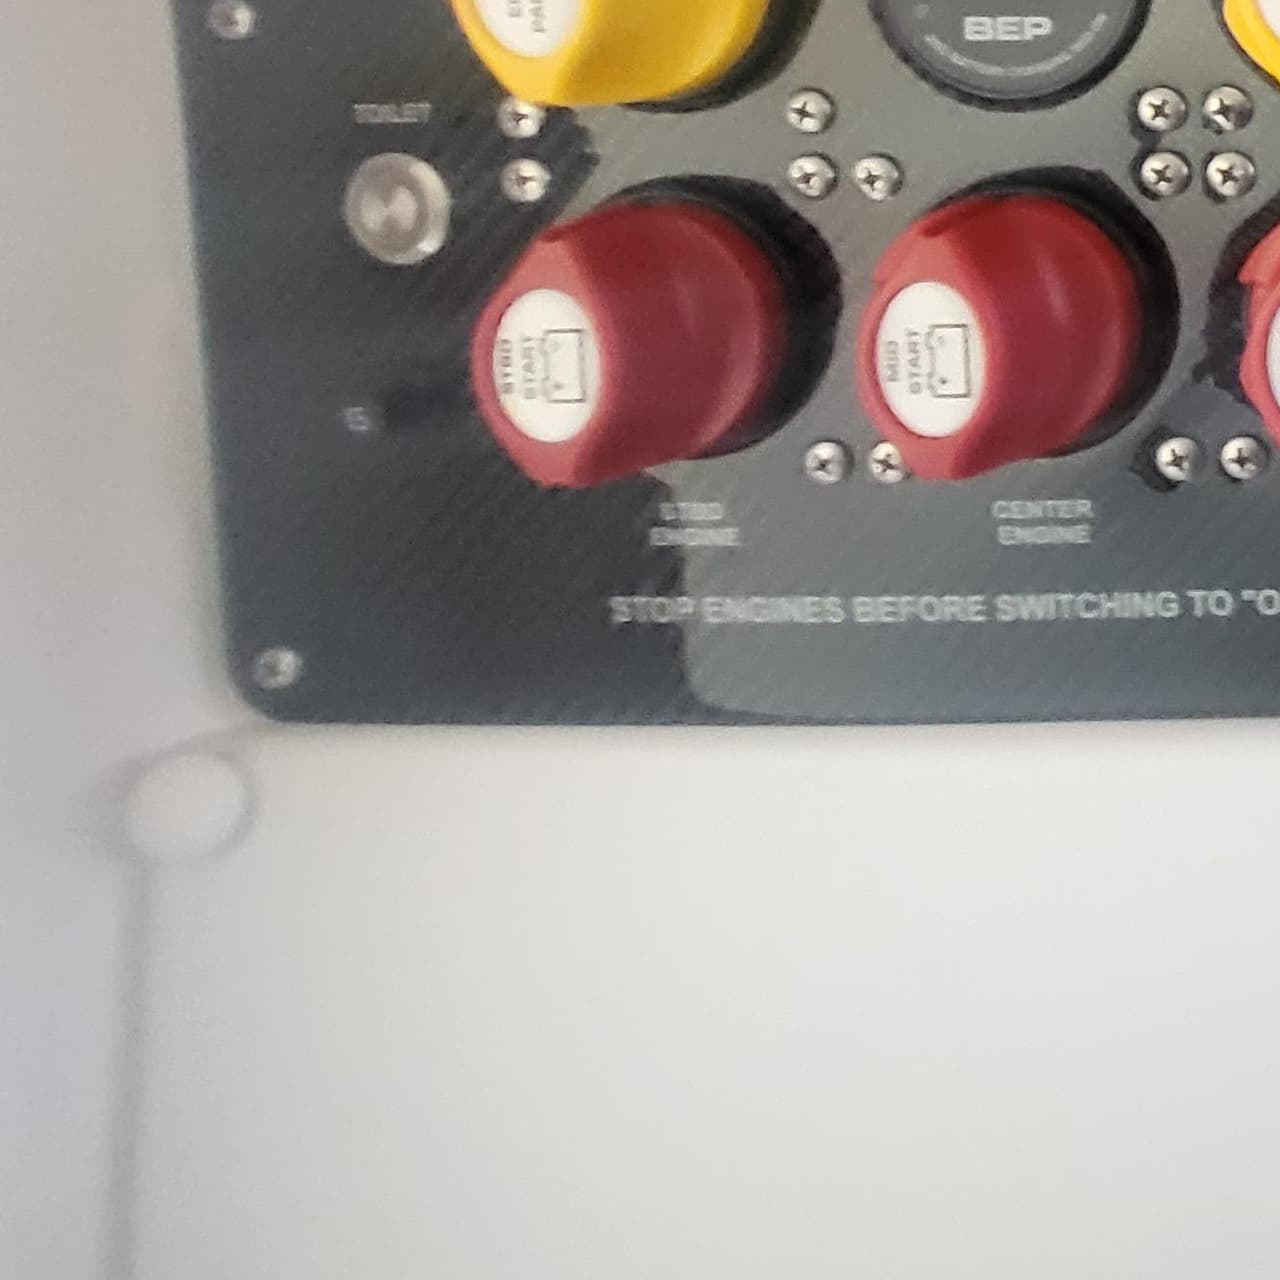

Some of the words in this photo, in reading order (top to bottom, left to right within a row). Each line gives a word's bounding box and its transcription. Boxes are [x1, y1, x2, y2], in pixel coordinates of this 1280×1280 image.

[964, 16, 1051, 41] BEP
[608, 596, 696, 623] STOP
[702, 596, 846, 623] ENGINES
[853, 594, 988, 622] BEFORE
[996, 591, 1179, 619] SWITCHING
[1186, 589, 1234, 616] TO
